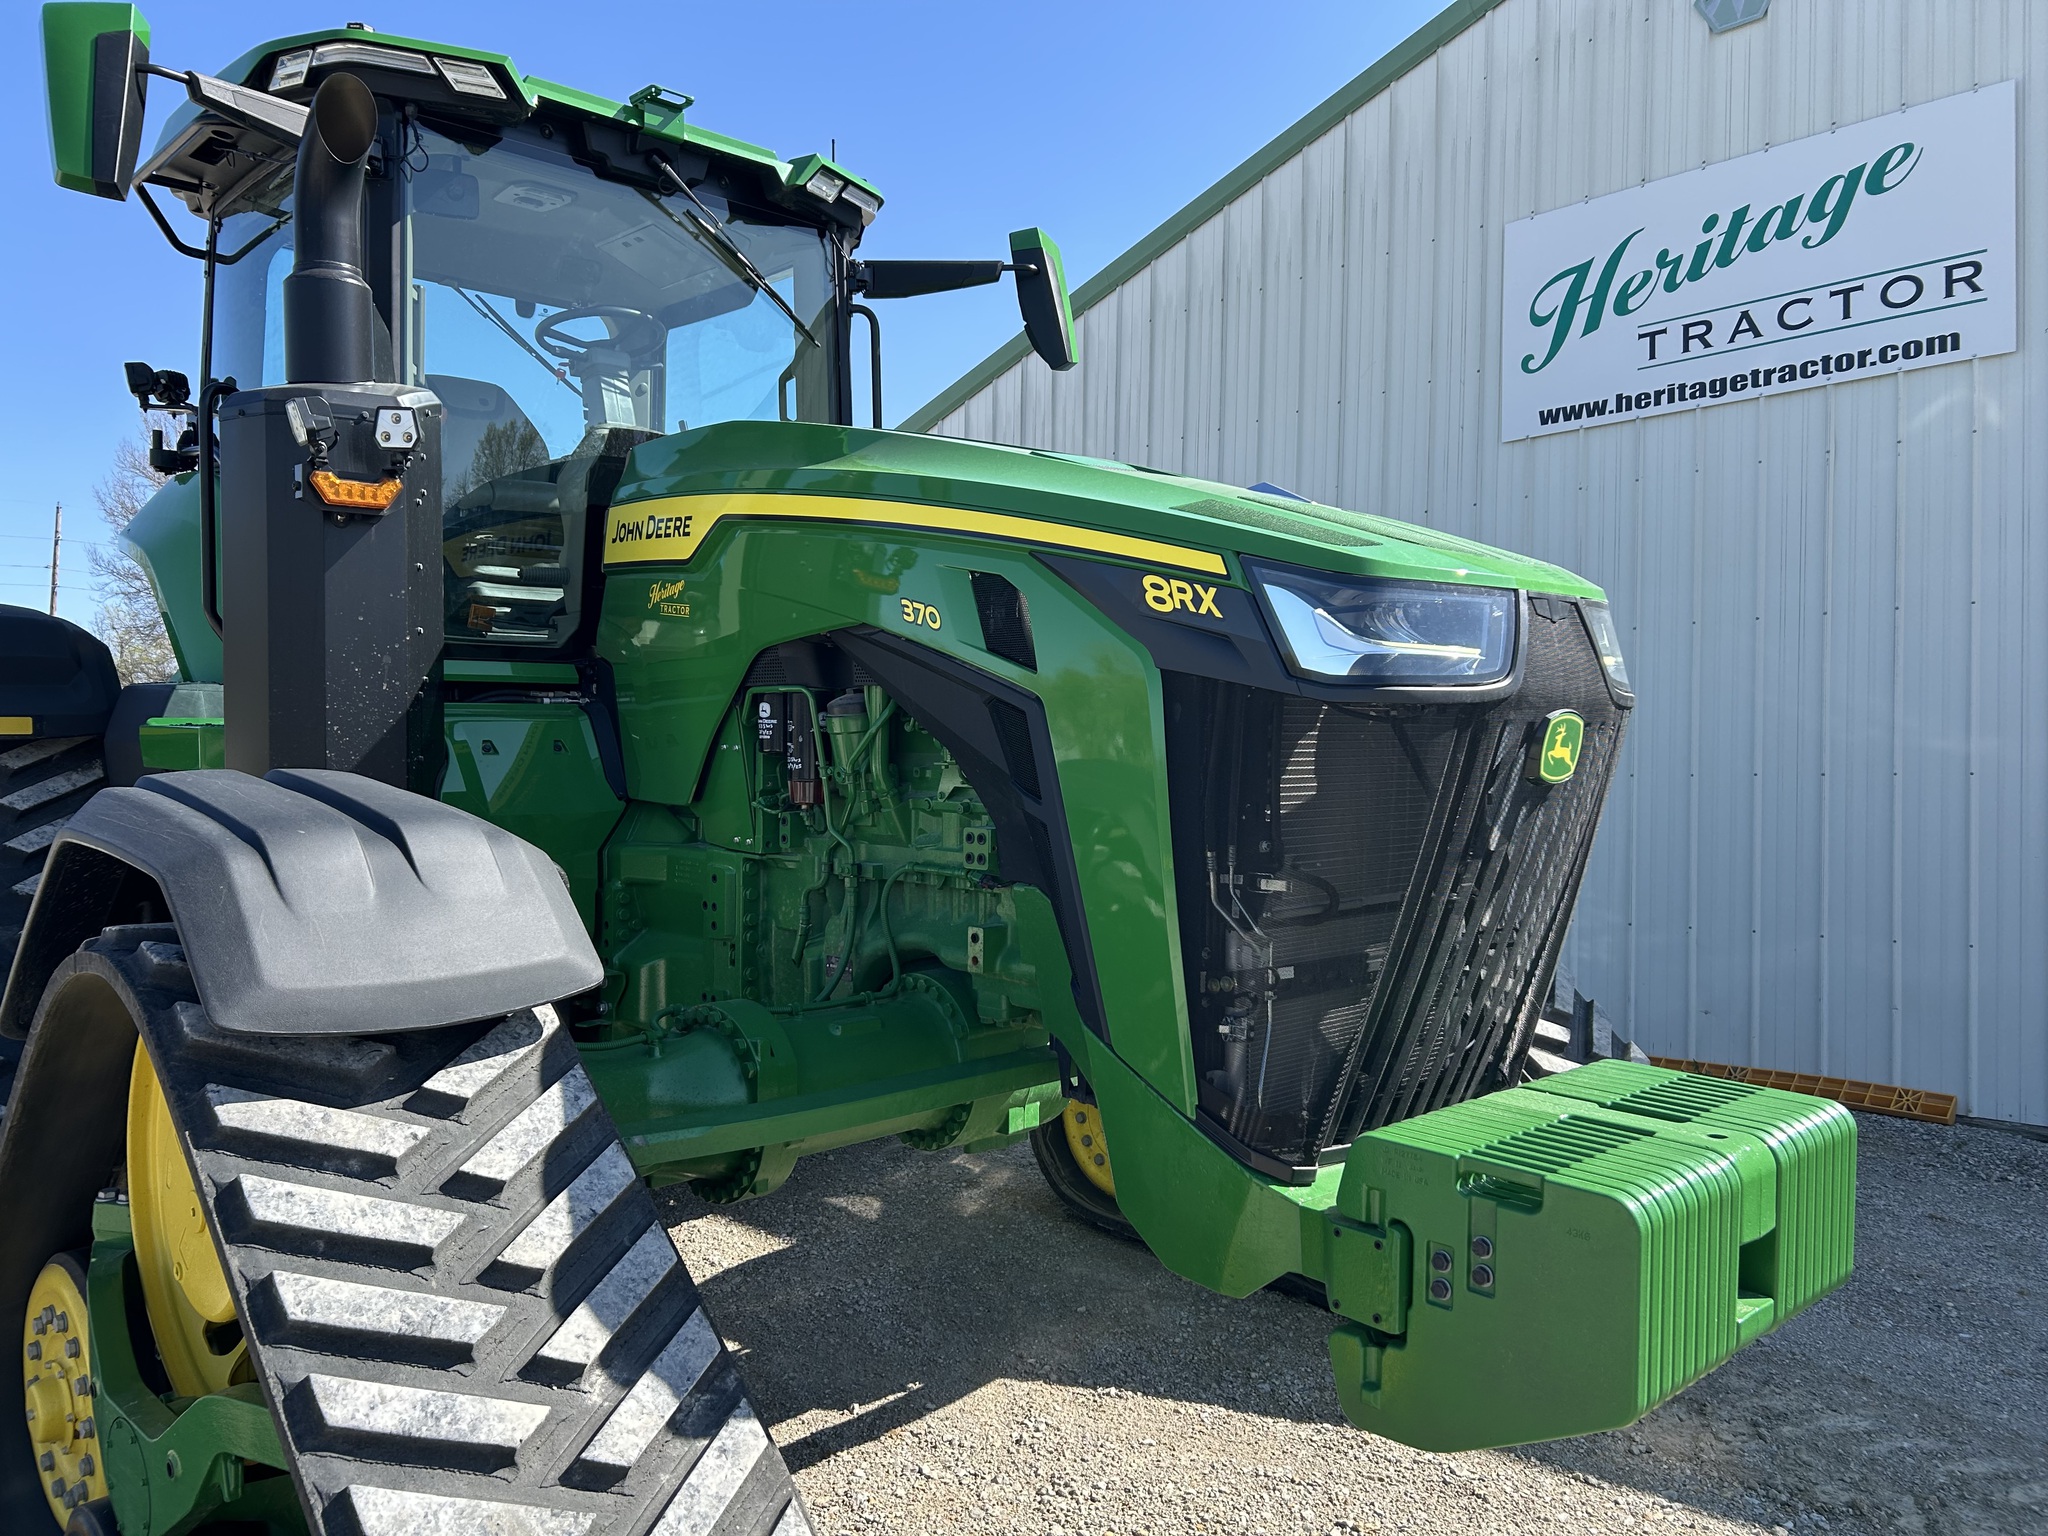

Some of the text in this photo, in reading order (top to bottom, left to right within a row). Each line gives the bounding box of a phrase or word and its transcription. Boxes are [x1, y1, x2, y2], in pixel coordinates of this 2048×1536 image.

[1521, 142, 1923, 373] Heritage
[1637, 260, 1985, 360] TRACTOR
[1538, 331, 1961, 426] www.heritagetractor.com
[611, 515, 693, 544] JOHN DEERE
[647, 579, 686, 609] Heritage
[660, 604, 690, 615] TRACTOR
[900, 597, 941, 630] 370
[1142, 574, 1223, 619] 8RX
